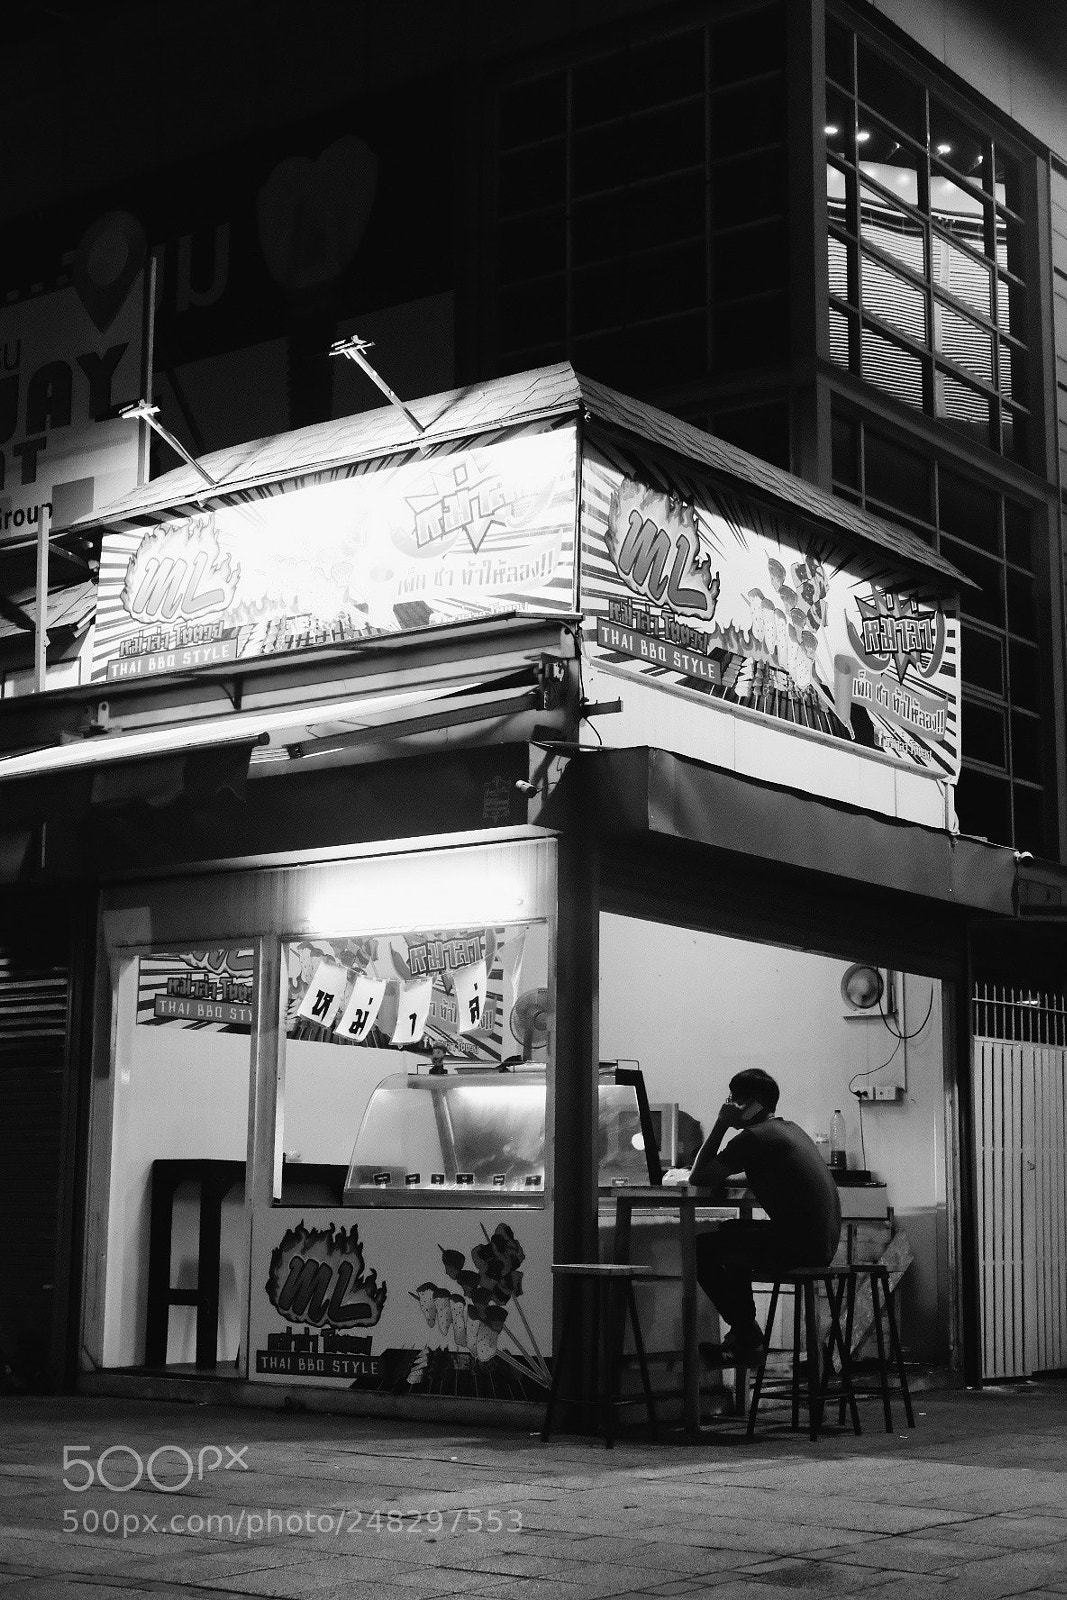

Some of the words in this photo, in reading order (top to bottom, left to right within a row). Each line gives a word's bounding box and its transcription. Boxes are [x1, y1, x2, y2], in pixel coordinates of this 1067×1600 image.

[863, 592, 934, 654] หม่าล่า
[111, 660, 141, 677] THAI
[148, 655, 176, 671] BBQ
[182, 644, 230, 664] STYLE
[602, 626, 632, 651] THAI
[640, 639, 667, 662] BBQ
[673, 651, 715, 679] STYLE
[160, 1000, 190, 1015] THAI
[197, 1004, 222, 1018] BBQ
[261, 1356, 291, 1370] THAI
[298, 1357, 324, 1371] BBQ
[332, 1360, 379, 1375] STYLE
